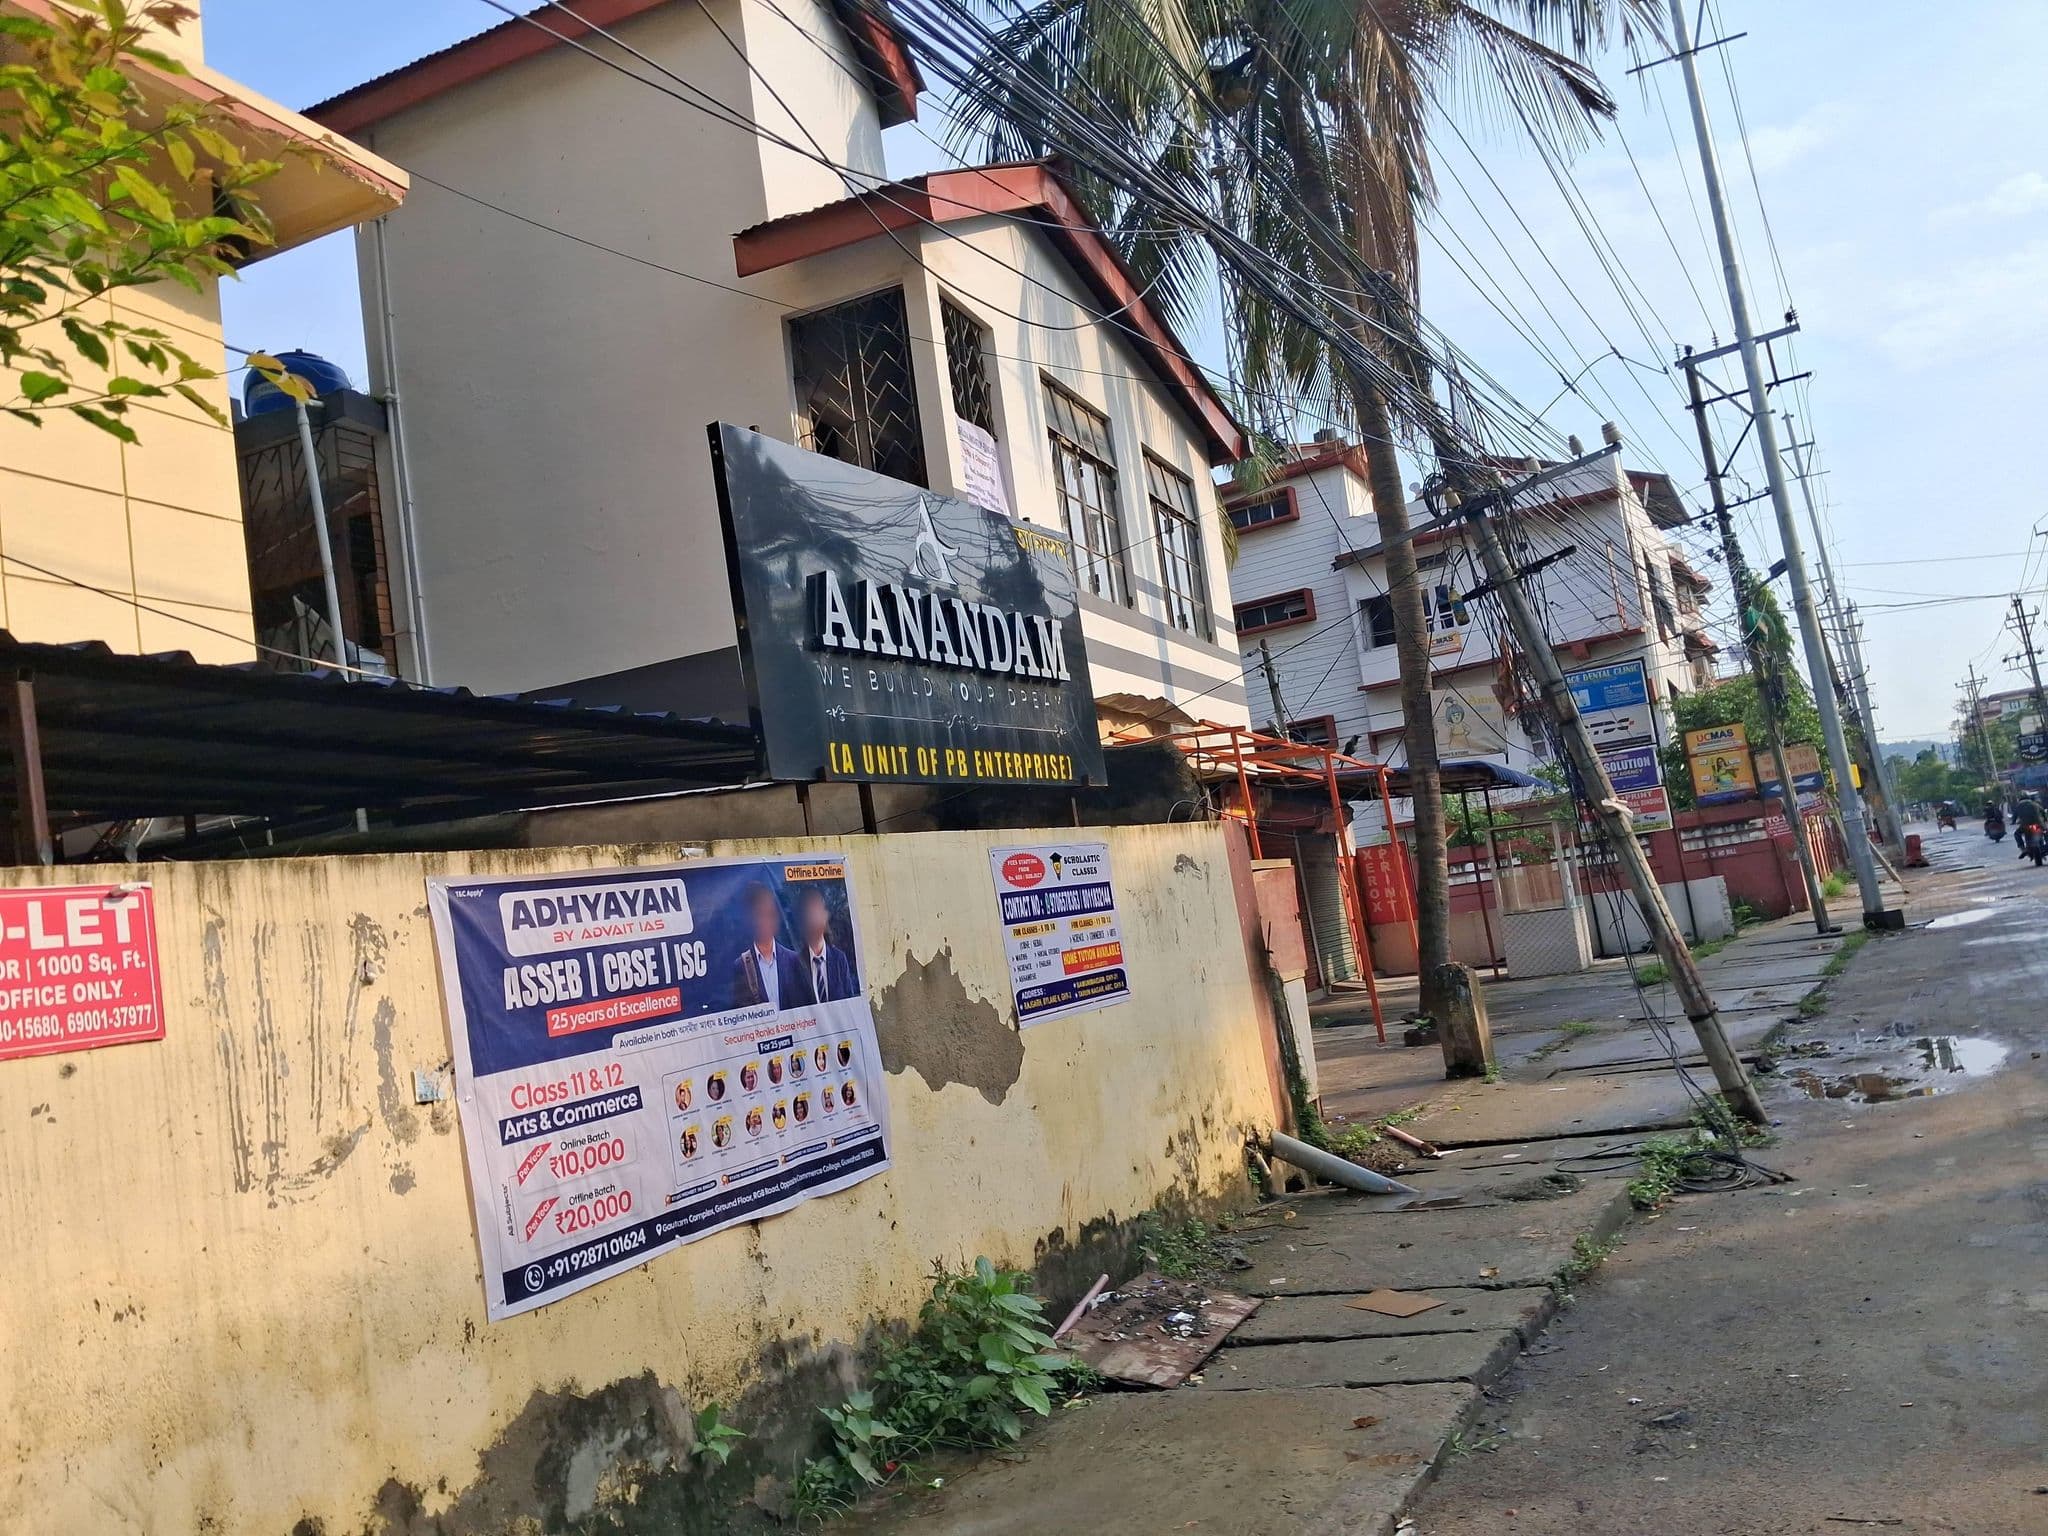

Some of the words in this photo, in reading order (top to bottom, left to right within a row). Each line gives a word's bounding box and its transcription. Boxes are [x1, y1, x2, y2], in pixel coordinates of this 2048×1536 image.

[822, 570, 1071, 681] AANANDAM
[819, 665, 851, 688] WE
[869, 670, 933, 697] BUILD
[1583, 668, 1612, 682] DENTAL
[1613, 663, 1640, 676] CLINIC
[1696, 728, 1734, 743] UCMAS
[862, 745, 908, 775] UNIT
[917, 747, 938, 776] OF
[946, 749, 968, 777] PB
[1604, 755, 1651, 773] SOLUTION
[787, 868, 812, 878] Offline
[813, 867, 818, 877] &
[818, 866, 842, 877] Online
[1064, 854, 1101, 867] SCHOLASTIC
[1072, 866, 1098, 877] CLASSES
[1362, 848, 1383, 913] XEROX
[1378, 847, 1398, 925] PRINT
[0, 896, 139, 950] -LET
[512, 886, 682, 931] ADHYAYAN
[1004, 895, 1032, 920] CONTACT
[553, 930, 574, 943] BY
[581, 922, 634, 939] ADVAIT
[640, 919, 665, 931] IAS
[37, 954, 83, 978] 1000
[88, 952, 117, 975] Sq.
[122, 950, 146, 969] Ft.
[503, 957, 584, 1010] ASSEB
[602, 946, 659, 993] CBSE
[674, 940, 708, 981] ISC
[0, 985, 67, 1011] OFFICE
[73, 979, 123, 1003] ONLY
[551, 1013, 569, 1030] 25
[570, 1008, 606, 1027] years
[607, 1002, 619, 1019] of
[620, 994, 678, 1016] Excellence
[0, 1014, 65, 1042] 0-15680,
[67, 1004, 152, 1034] 69001-37977
[619, 1033, 653, 1048] Available
[653, 1032, 661, 1041] in
[662, 1029, 679, 1040] both
[718, 1018, 723, 1026] &
[724, 1013, 747, 1026] English
[748, 1008, 775, 1020] Medium
[724, 1033, 755, 1045] Securing
[755, 1028, 775, 1038] Ranks
[780, 1022, 796, 1032] State
[796, 1018, 816, 1030] Highest
[760, 1043, 770, 1052] For
[771, 1041, 778, 1049] 25
[511, 1080, 569, 1110] Class
[570, 1072, 586, 1095] 11
[589, 1068, 604, 1092] &
[604, 1063, 624, 1087] 12
[504, 1117, 538, 1141] Arts
[540, 1111, 551, 1131] &
[552, 1092, 638, 1126] Commerce
[560, 1137, 586, 1152] Online
[587, 1130, 611, 1144] Batch
[518, 1167, 529, 1180] Per
[527, 1146, 544, 1166] Year
[550, 1138, 625, 1179] ₹10,000
[569, 1191, 594, 1206] Offline
[594, 1183, 616, 1197] Batch
[663, 1218, 688, 1232] Gautam
[688, 1208, 715, 1223] Complex,
[714, 1199, 737, 1213] Ground
[737, 1194, 753, 1206] Floor,
[753, 1189, 765, 1200] RGB
[526, 1221, 537, 1235] Per
[535, 1201, 551, 1220] Year
[555, 1190, 632, 1234] ₹20,000
[547, 1257, 570, 1279] +91
[571, 1243, 609, 1270] 92871
[610, 1228, 647, 1255] 01624
